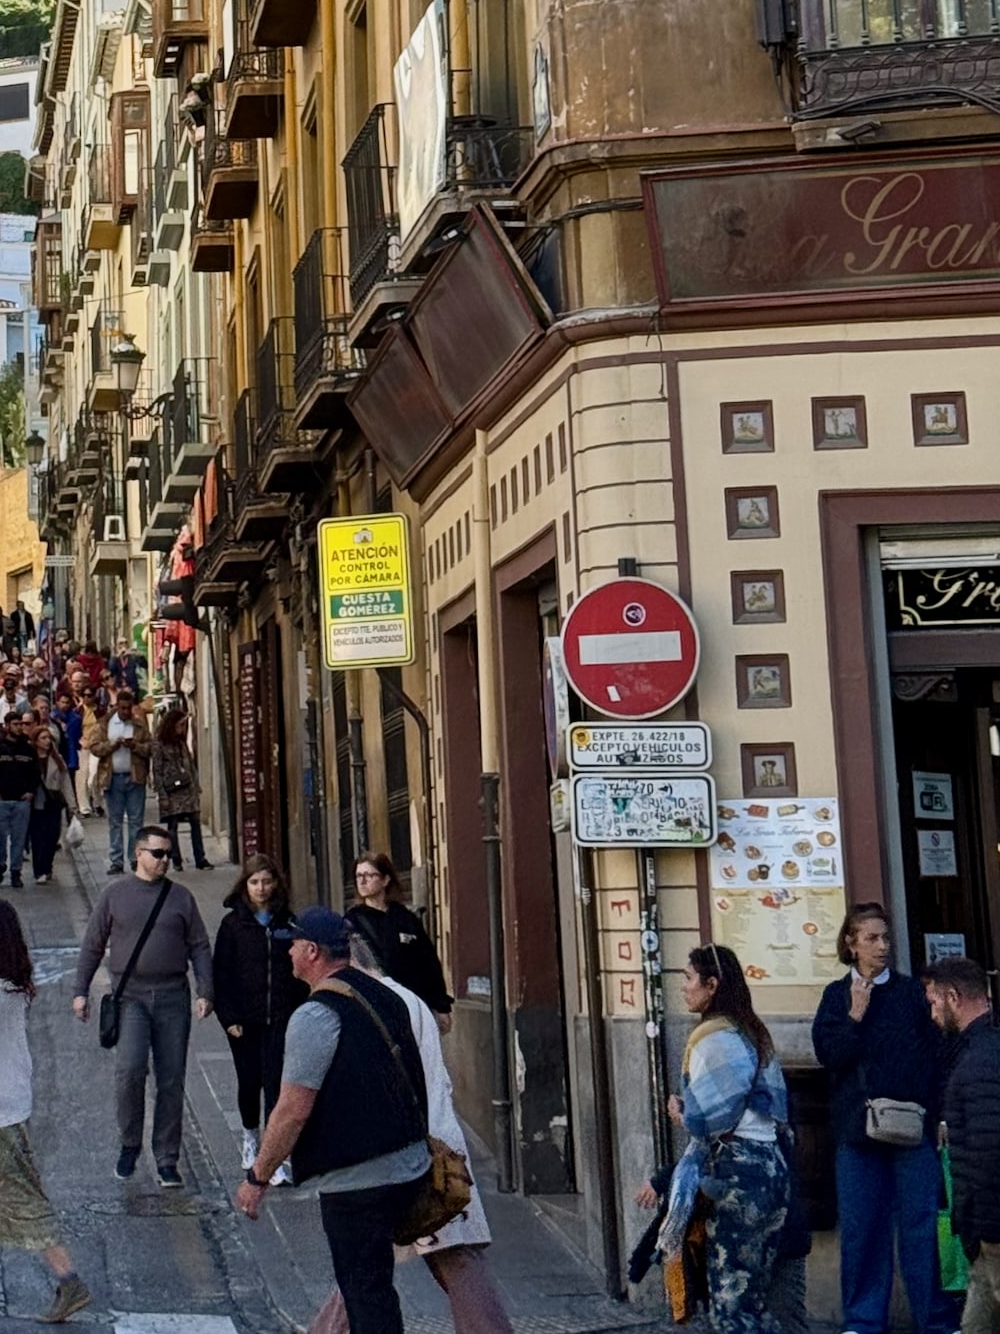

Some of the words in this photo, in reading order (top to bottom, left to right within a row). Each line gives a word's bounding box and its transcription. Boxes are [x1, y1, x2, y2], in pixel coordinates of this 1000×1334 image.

[331, 542, 398, 562] ATENCIÓN
[339, 561, 391, 573] CONTROL
[330, 576, 351, 586] POR
[341, 592, 391, 606] CUESTA
[333, 627, 359, 636] EXCEPTO
[577, 743, 631, 752] EXCEPTO
[632, 742, 702, 753] VEHICULOS
